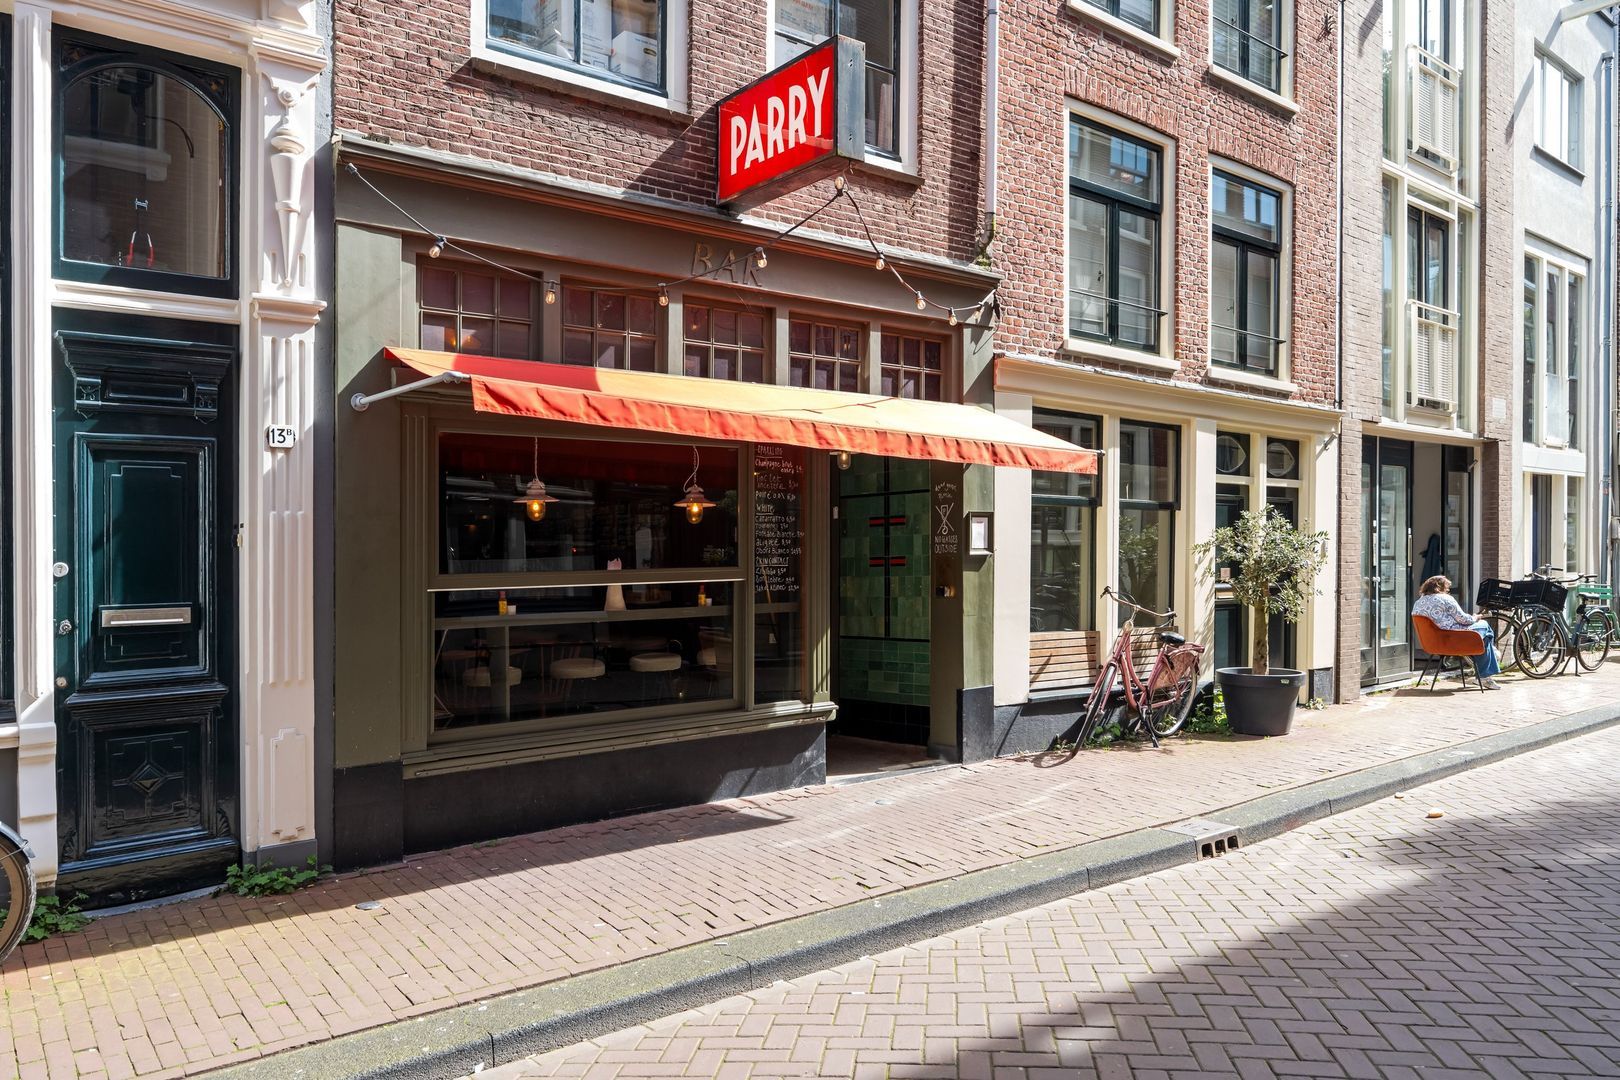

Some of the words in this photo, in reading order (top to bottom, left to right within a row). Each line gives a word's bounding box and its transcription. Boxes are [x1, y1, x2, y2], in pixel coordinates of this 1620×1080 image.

[730, 66, 830, 176] PARRY
[691, 242, 763, 288] BAR
[934, 544, 958, 554] OUTSIDE
